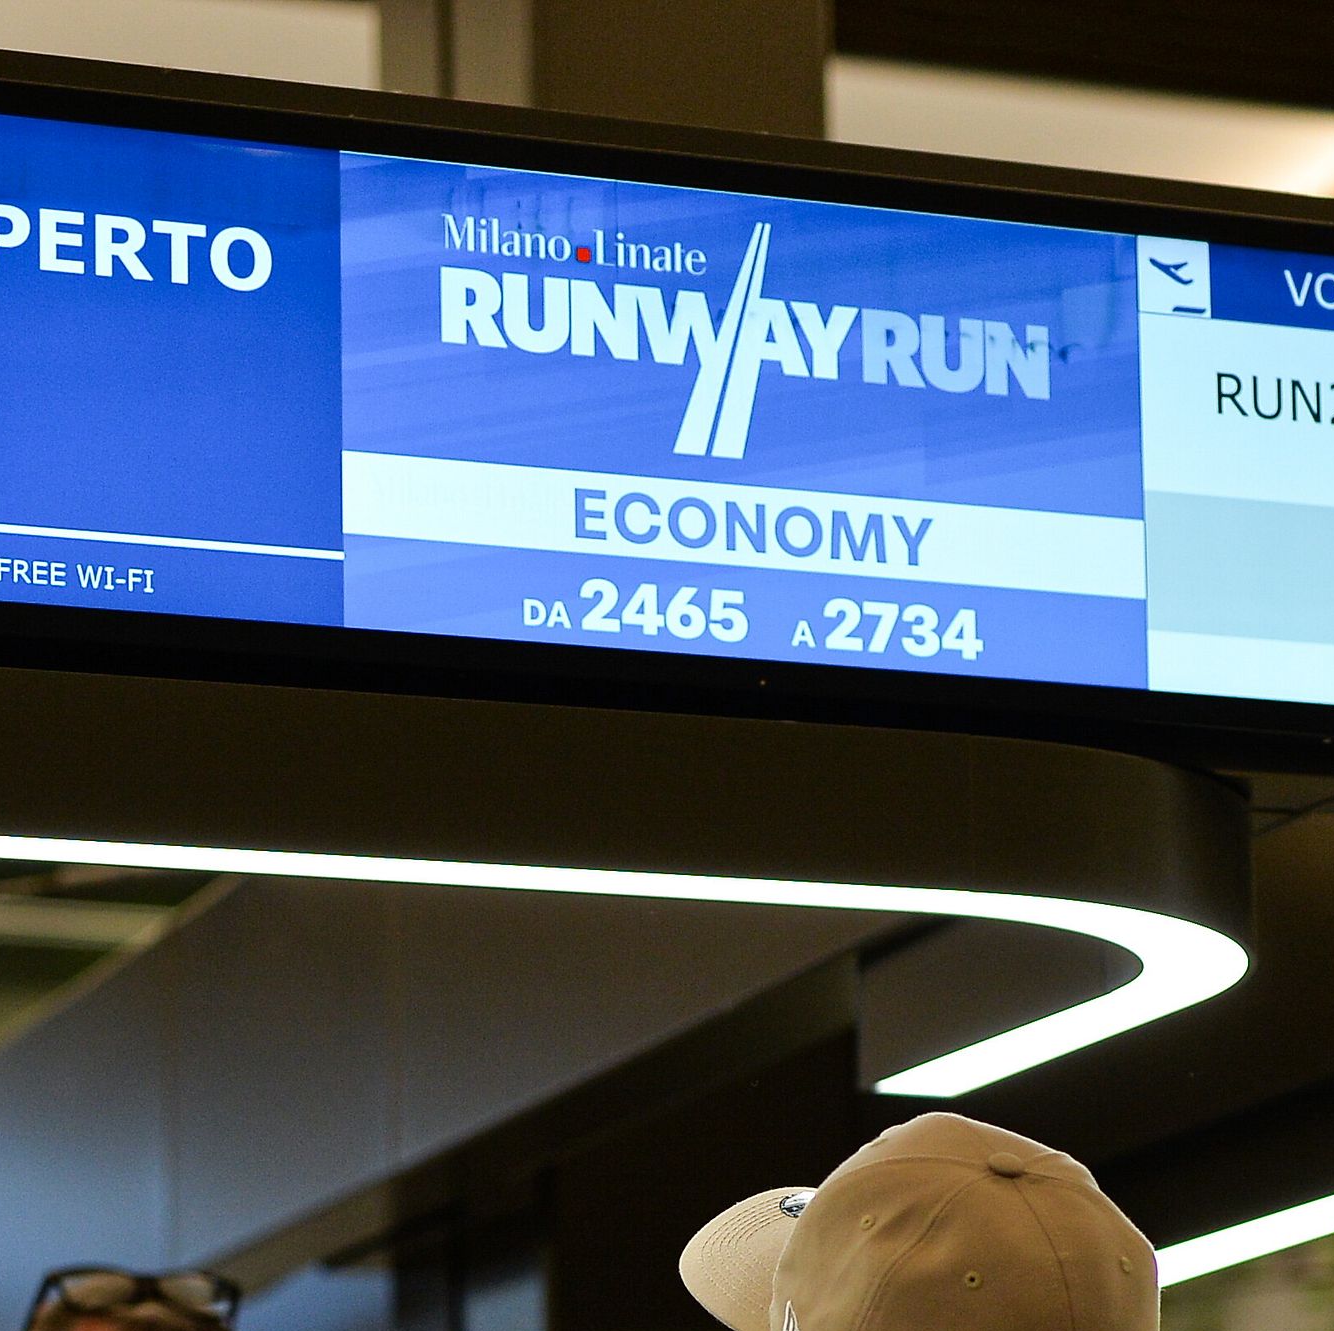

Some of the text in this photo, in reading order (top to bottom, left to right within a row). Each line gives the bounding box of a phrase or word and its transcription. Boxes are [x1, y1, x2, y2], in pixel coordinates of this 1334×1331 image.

[574, 486, 933, 567] ECONOMY
[76, 564, 155, 594] WI-FI
[522, 577, 984, 661] DA 2465 A 2734
